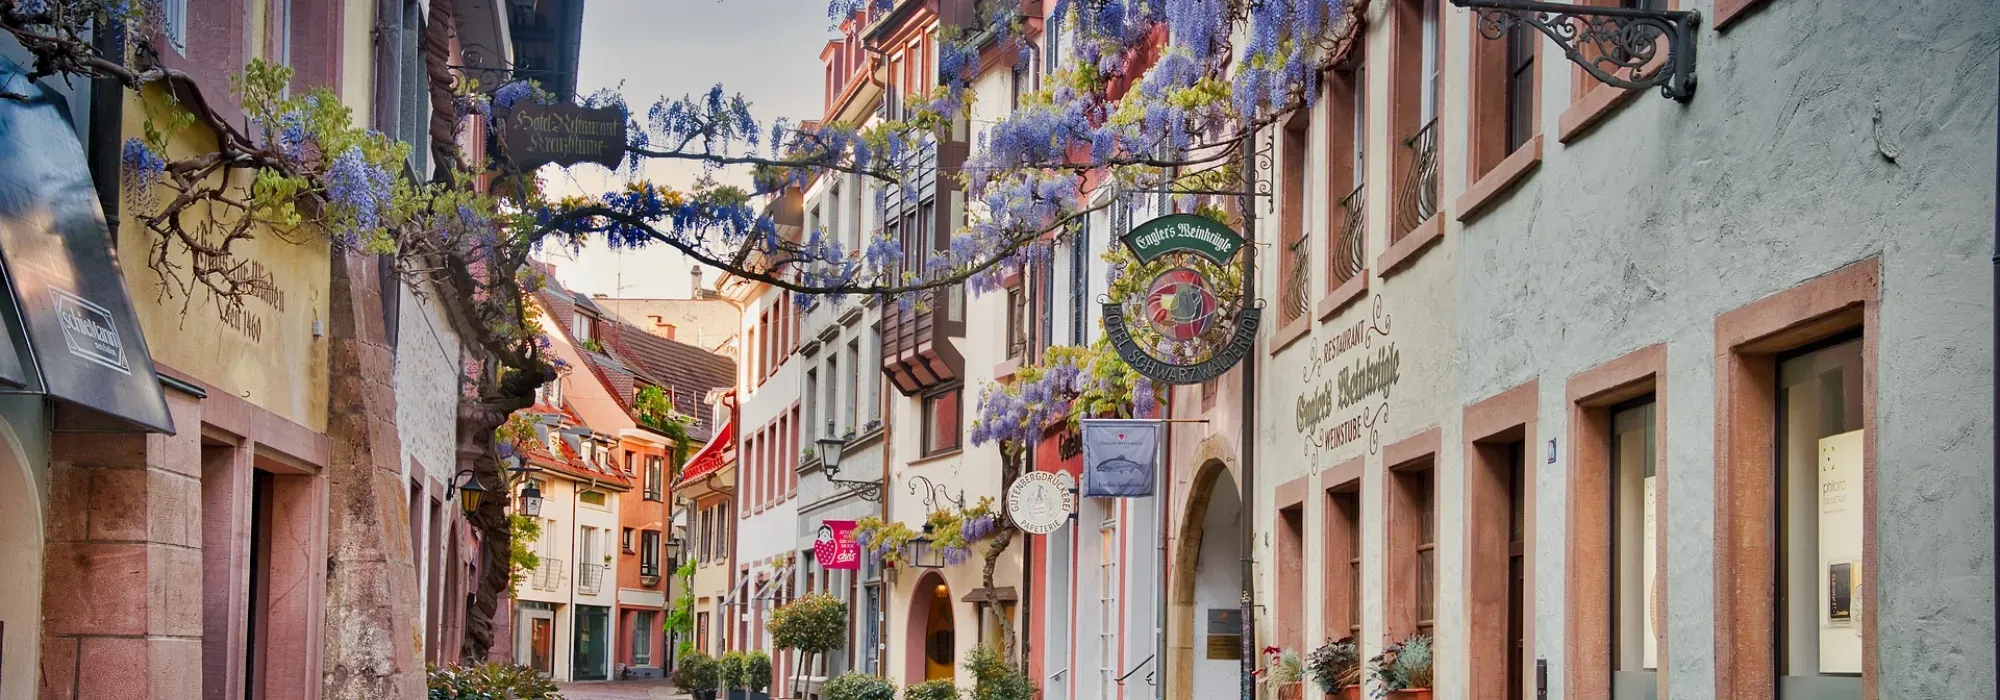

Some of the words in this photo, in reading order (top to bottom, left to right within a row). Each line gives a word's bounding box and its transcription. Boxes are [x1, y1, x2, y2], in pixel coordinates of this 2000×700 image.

[526, 131, 608, 158] Kreuzblume
[1135, 224, 1176, 249] Engler's
[1178, 223, 1232, 252] Weinkrügle
[243, 310, 261, 344] 1460
[1104, 306, 1128, 350] HOTEL
[1323, 319, 1365, 363] RESTAURANT
[1296, 379, 1332, 436] Engler's
[1337, 342, 1400, 410] Weinkrügle
[1325, 415, 1361, 452] WEINSTUBE
[1011, 472, 1071, 512] GUTENBERGDRUCKEREI
[1021, 519, 1060, 533] PAPETERIE
